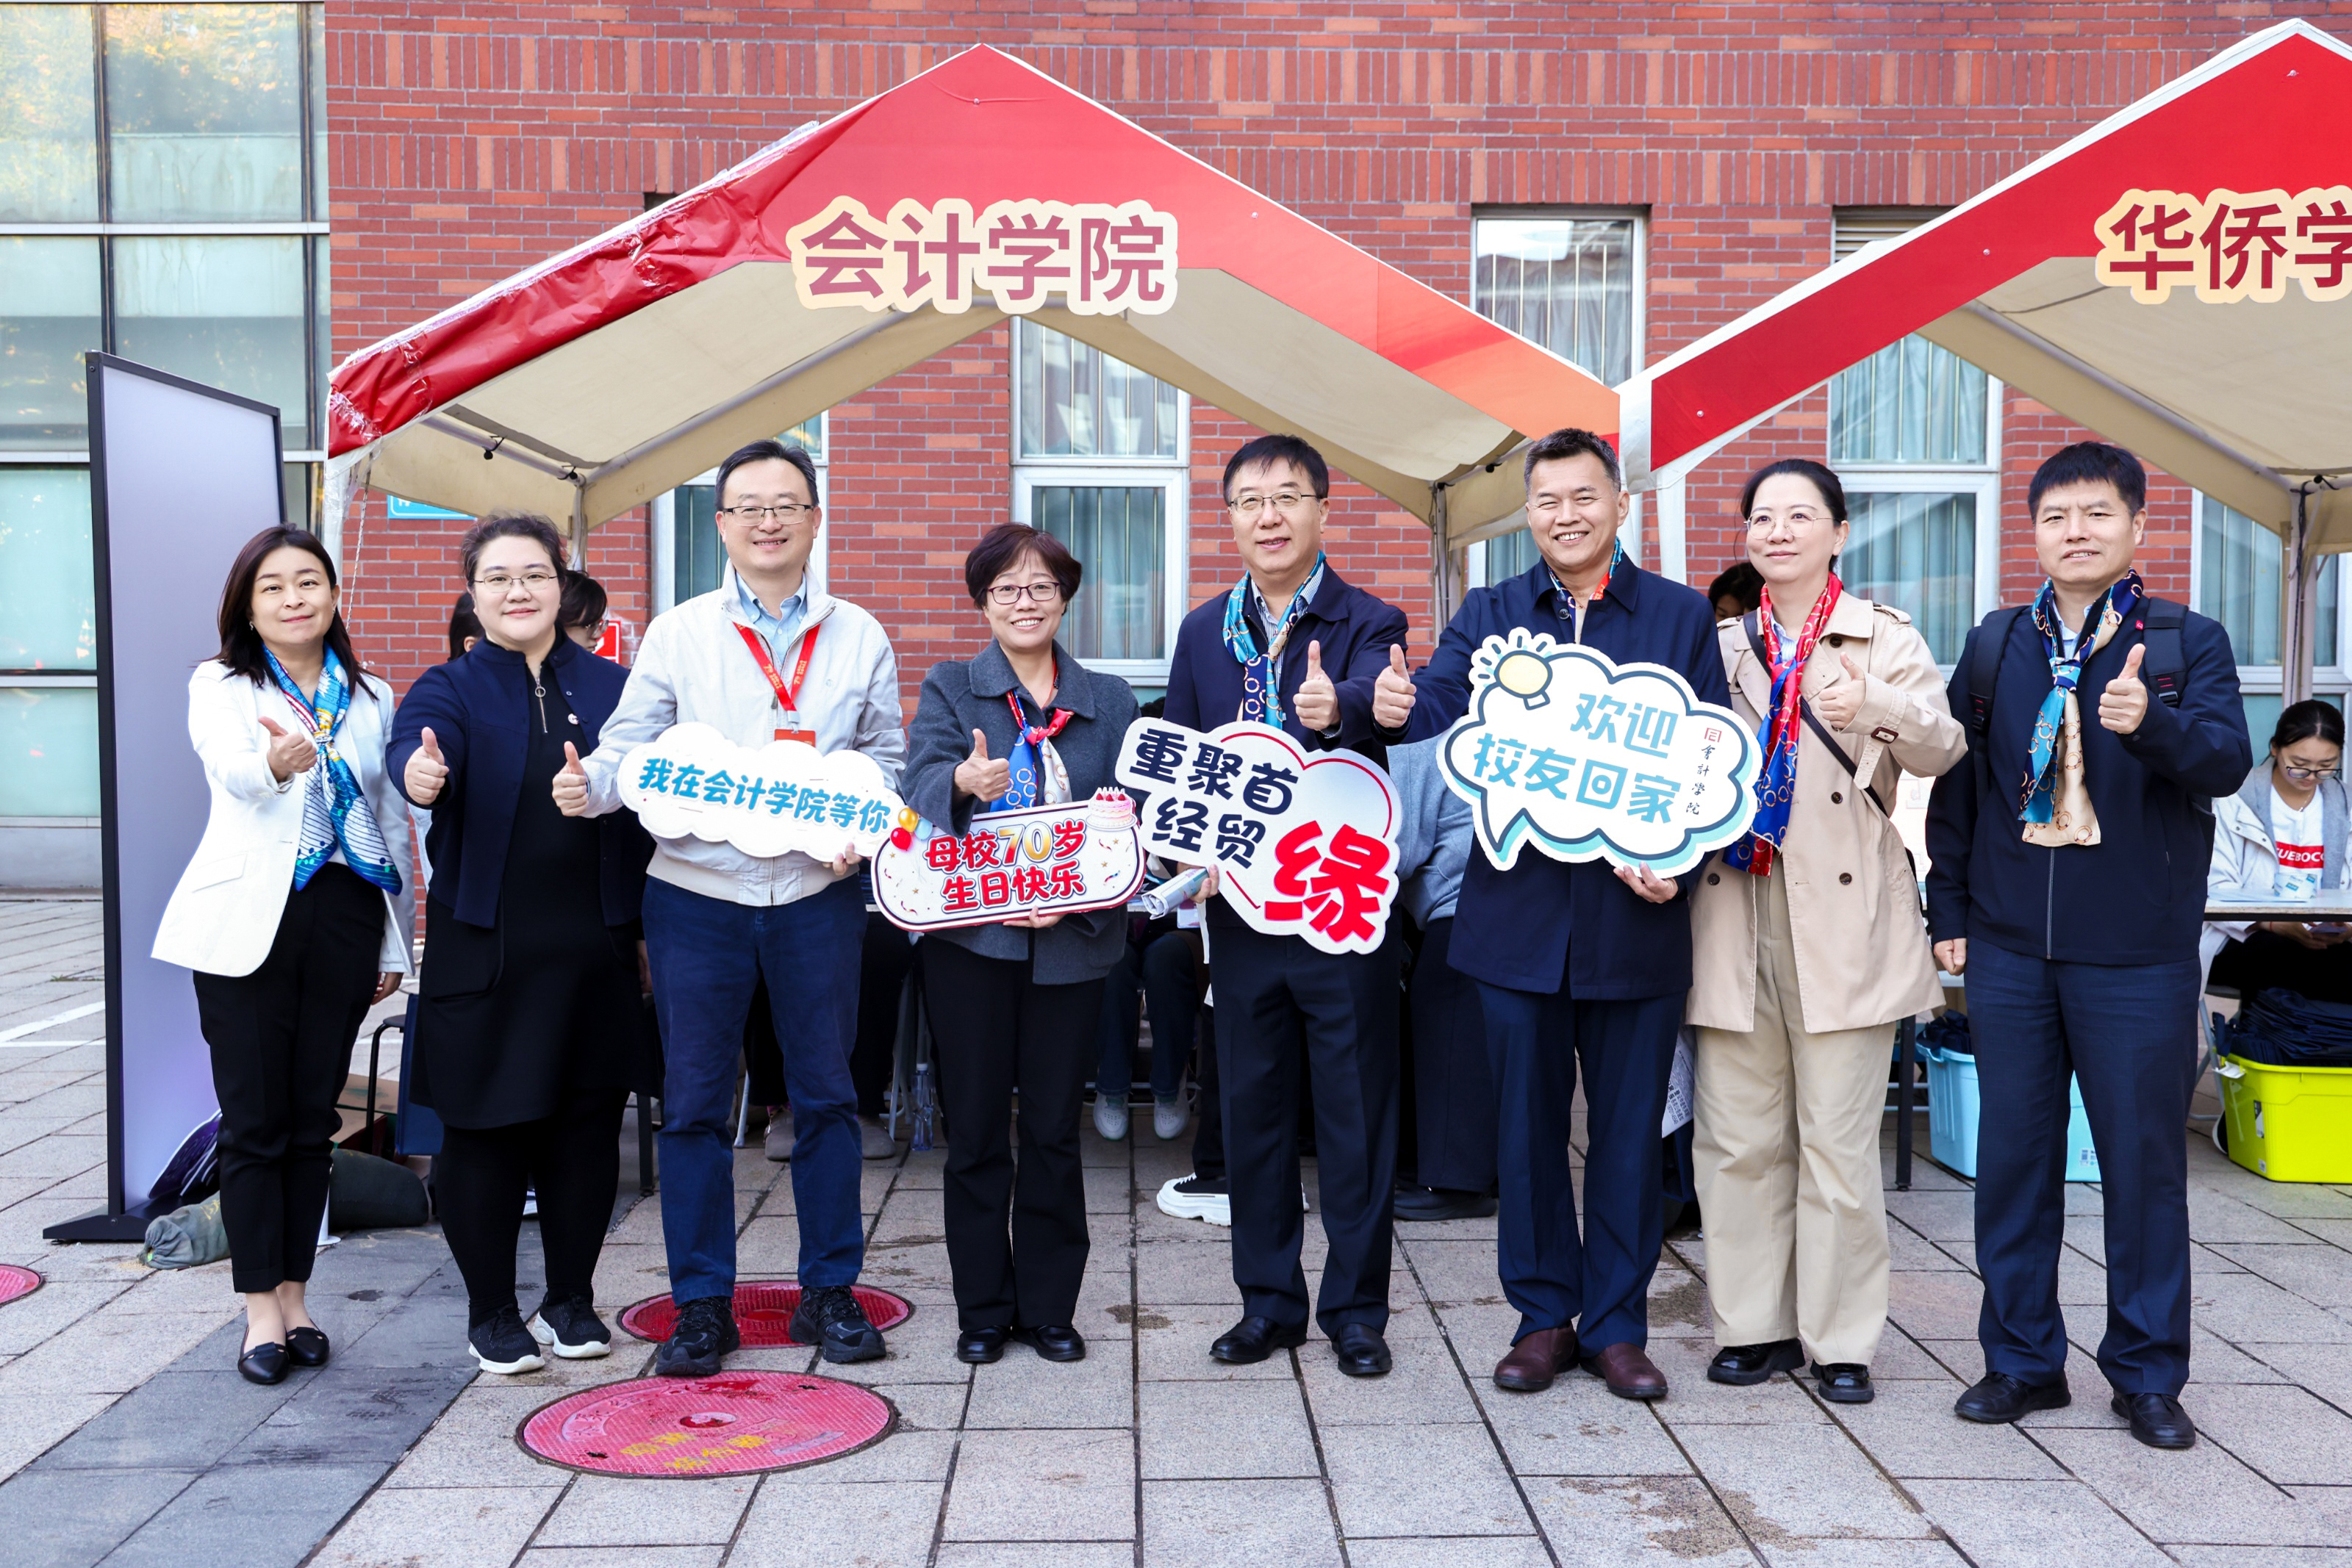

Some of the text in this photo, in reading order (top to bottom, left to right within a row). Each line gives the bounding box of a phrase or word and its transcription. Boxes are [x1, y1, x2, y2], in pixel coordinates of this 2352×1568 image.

[800, 210, 1164, 301] 会计学院
[2109, 200, 2352, 290] 华侨学
[1569, 692, 1679, 759] 欢迎
[638, 758, 891, 833] 我在会计学院等你
[1128, 727, 1299, 816] 重聚首
[1473, 733, 1682, 824] 校友回家
[925, 819, 1086, 872] 母校70岁
[1152, 796, 1267, 869] 经贸
[2276, 848, 2324, 863] UEBOC
[942, 860, 1084, 912] 生日快乐
[1264, 820, 1390, 943] 缘
